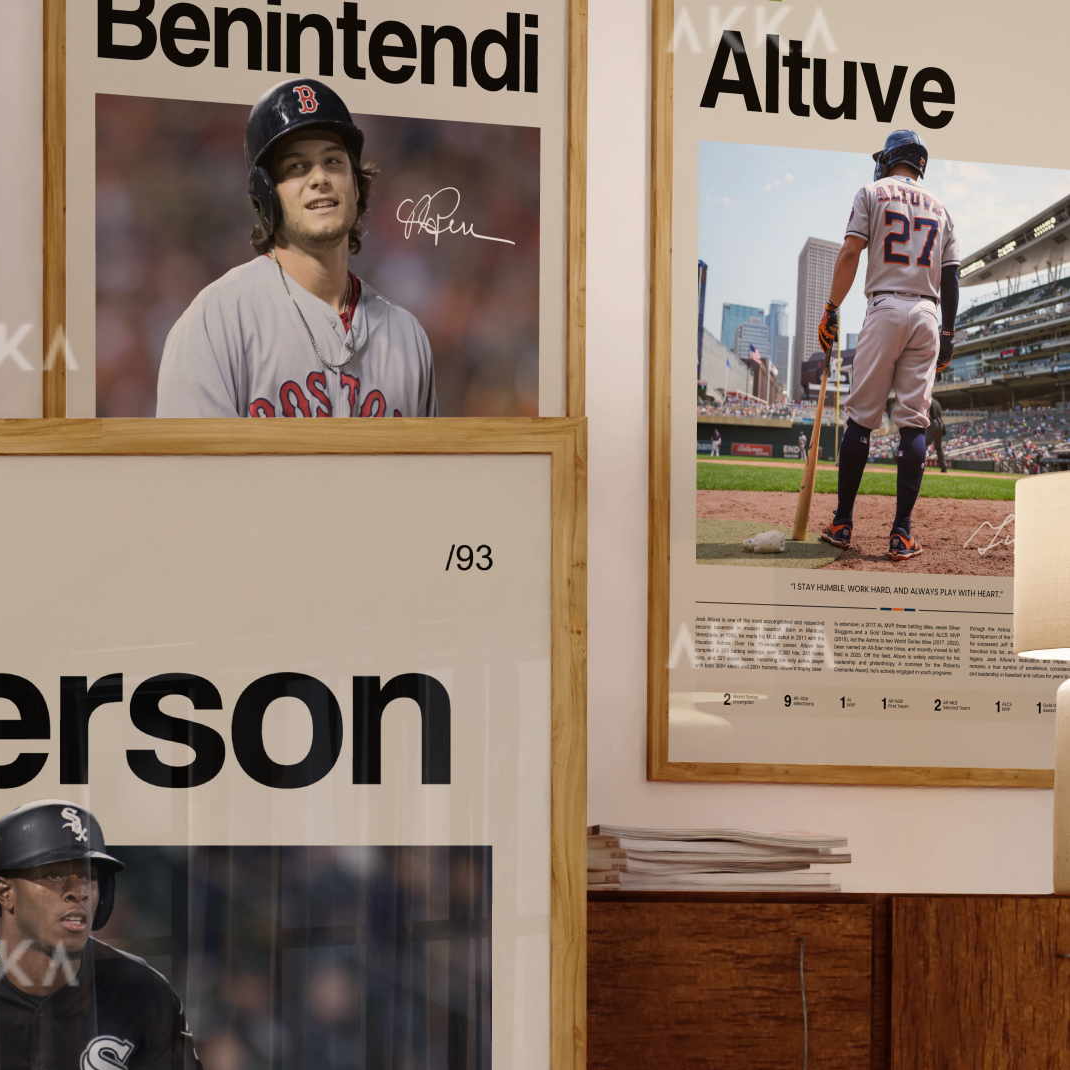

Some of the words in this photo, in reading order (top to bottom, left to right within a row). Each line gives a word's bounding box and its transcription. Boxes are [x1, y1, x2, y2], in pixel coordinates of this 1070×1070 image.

[97, 0, 539, 93] Benintendi
[700, 30, 955, 129] Altuve
[292, 84, 320, 114] B
[876, 184, 944, 217] ALTUVE
[883, 209, 940, 269] 27
[445, 544, 493, 571] /93
[798, 583, 815, 591] STAY
[816, 584, 846, 594] HUMBLE,
[847, 585, 869, 593] WORK
[871, 586, 892, 595] HARD,
[893, 586, 909, 595] AND
[910, 587, 938, 596] ALWAYS
[940, 588, 957, 596] PLAY
[958, 589, 976, 597] WITH
[976, 590, 1004, 598] HEART.”
[723, 693, 731, 705] 2
[784, 695, 792, 707] 9
[840, 697, 845, 708] 1
[881, 698, 887, 709] 1
[934, 699, 941, 711] 2
[995, 701, 1000, 712] 1
[1036, 702, 1042, 714] 1
